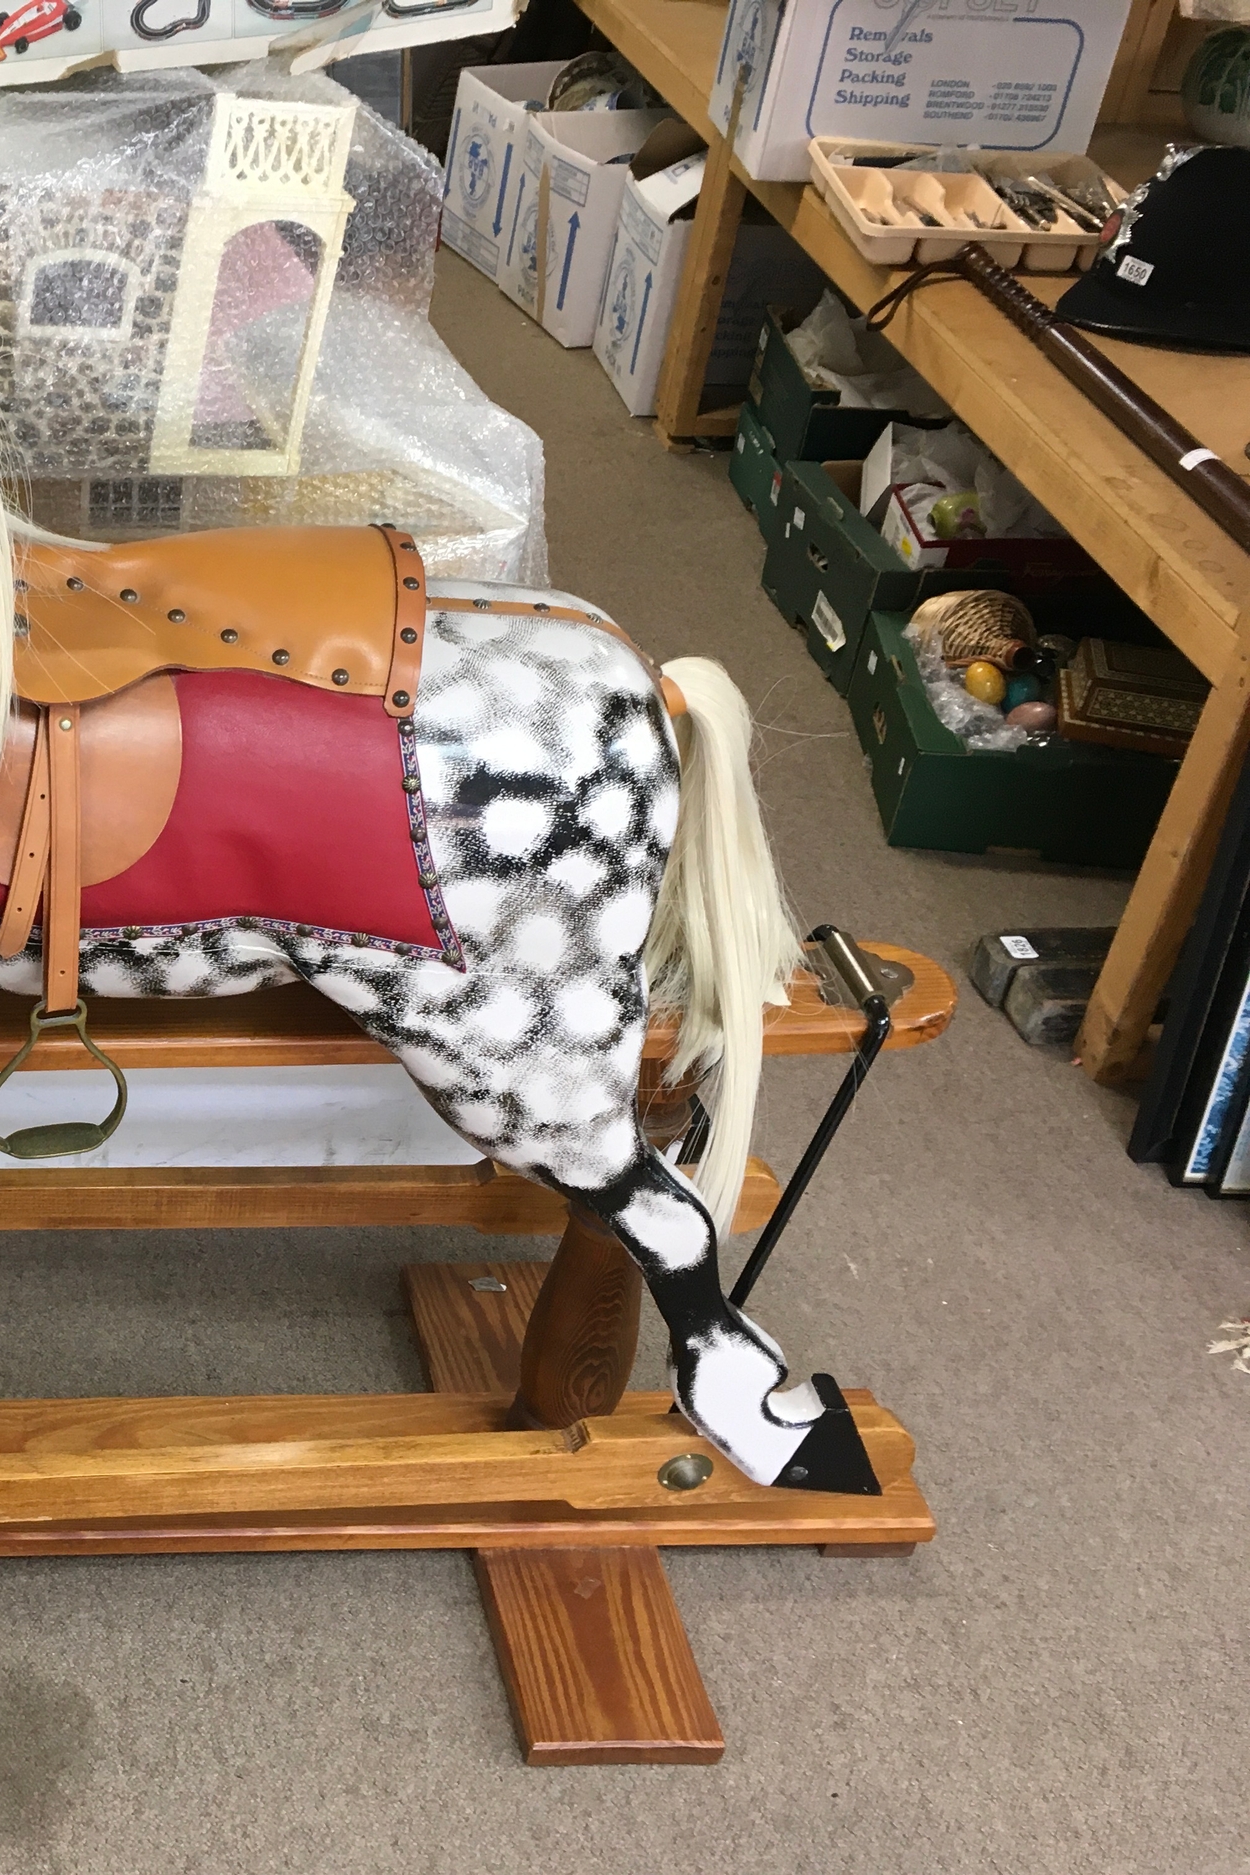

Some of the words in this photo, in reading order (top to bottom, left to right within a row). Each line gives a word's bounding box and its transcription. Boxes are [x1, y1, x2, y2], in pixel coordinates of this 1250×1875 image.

[849, 27, 933, 43] Remals
[845, 47, 913, 66] Storage
[839, 69, 906, 87] Packing
[930, 80, 970, 88] LONDON
[834, 89, 911, 108] Shipping
[928, 90, 975, 99] ROMFORD
[925, 100, 985, 110] BRENTWOOD
[922, 111, 973, 120] SOUTHEND
[1123, 262, 1147, 279] 1650
[1011, 939, 1031, 955] 1826
